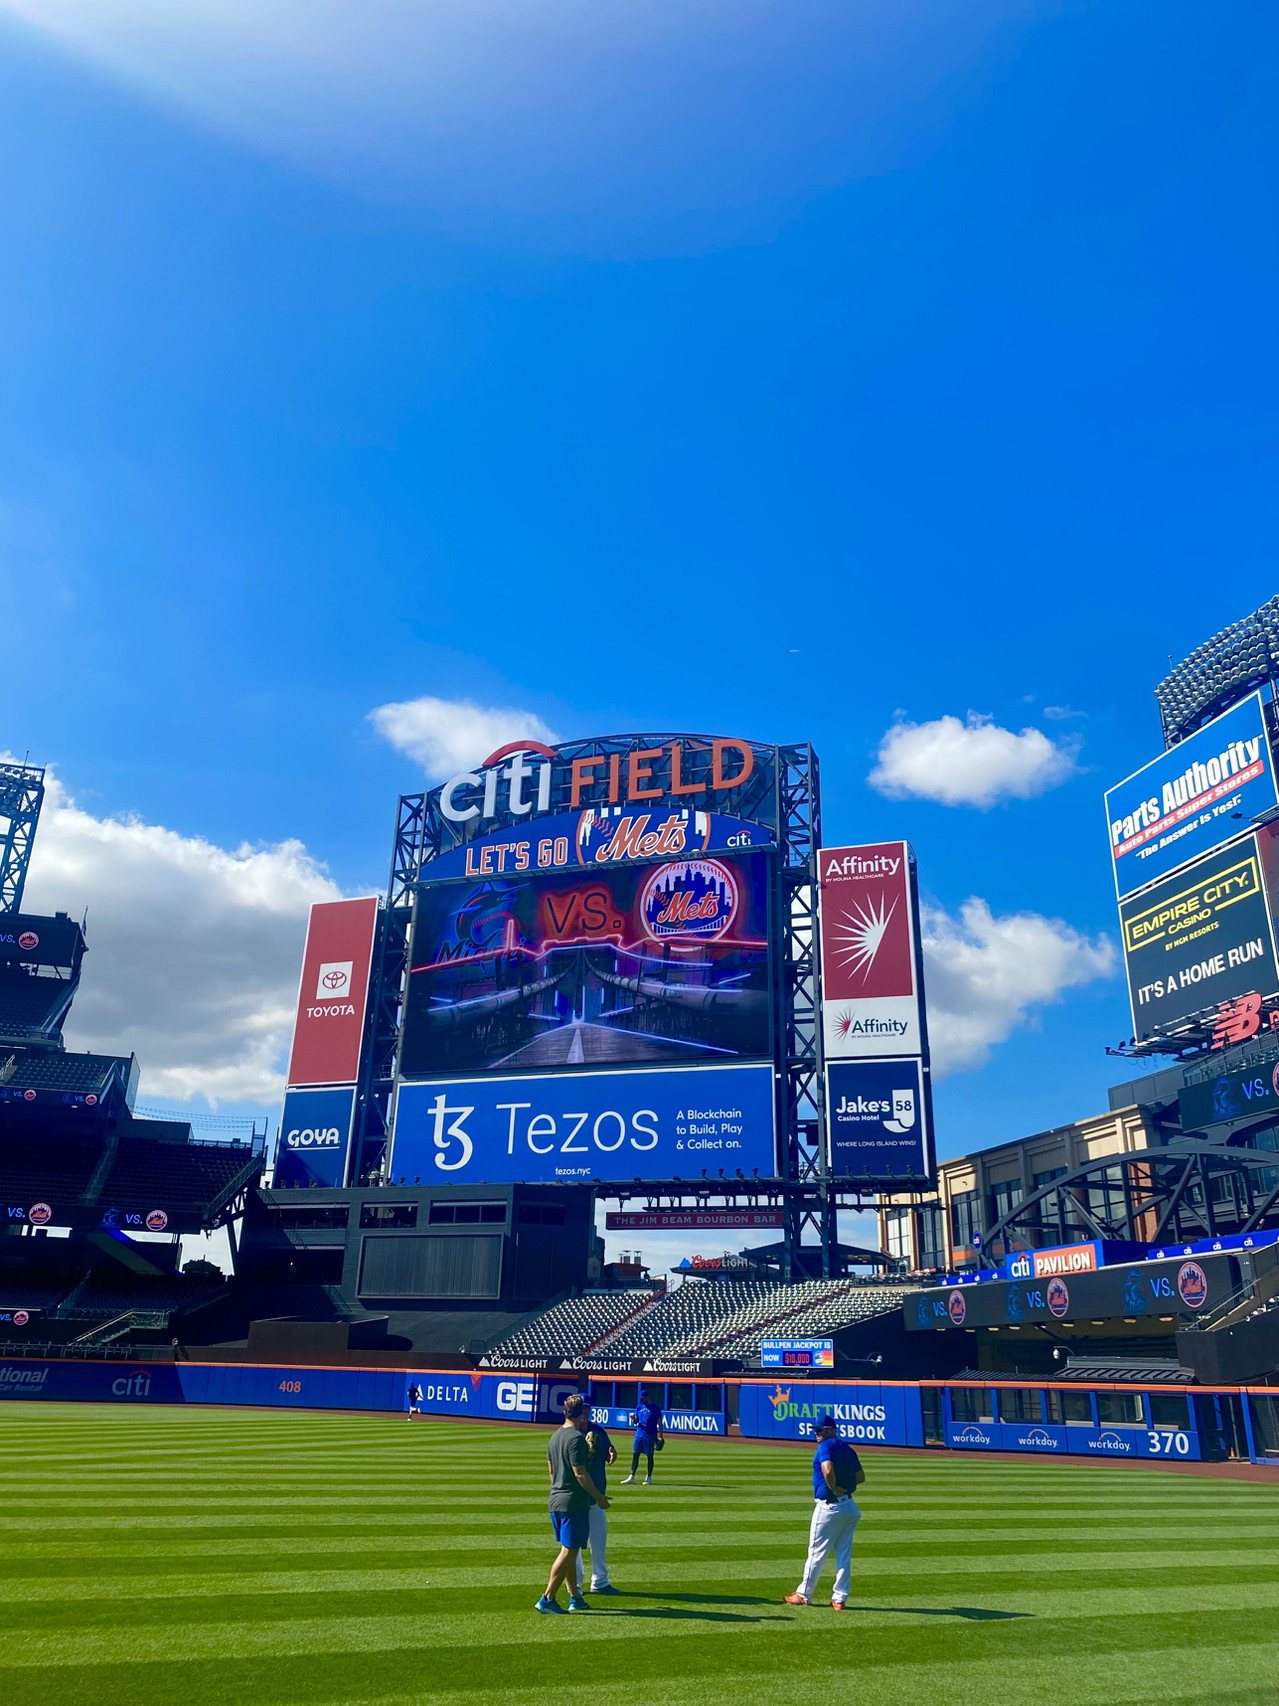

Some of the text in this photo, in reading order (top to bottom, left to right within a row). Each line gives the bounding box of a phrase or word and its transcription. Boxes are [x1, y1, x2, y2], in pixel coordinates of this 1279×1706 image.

[440, 739, 753, 822] citi FIELD
[1111, 736, 1260, 846] Parts Authority
[1118, 765, 1259, 854] Auto Parts Super Stores
[727, 833, 751, 847] citi
[1160, 819, 1198, 846] Answer
[465, 814, 688, 875] LET'S GO Mets
[826, 855, 900, 876] Affinity
[547, 892, 621, 933] VS.
[657, 891, 719, 922] Mets
[1132, 896, 1200, 939] EMPIRE
[1168, 909, 1211, 935] CASINO
[1165, 942, 1174, 951] BY
[1189, 921, 1219, 940] RESORTS
[1138, 938, 1264, 1005] IT'S A HOME RUN
[307, 1005, 355, 1018] TOYOTA
[851, 1018, 908, 1036] Affinity
[1242, 1079, 1269, 1100] VS.
[836, 1096, 912, 1113] Jake's 58
[676, 1108, 742, 1120] A Blockchain
[496, 1103, 658, 1154] Tezos
[676, 1123, 742, 1135] to Build, Play
[287, 1128, 339, 1147] GOYA
[676, 1139, 742, 1149] & Collect on.
[555, 1167, 591, 1176] tezos.nyc
[8, 1208, 26, 1218] VS.
[126, 1214, 143, 1224] VS.
[662, 1216, 691, 1224] BEAM
[754, 1215, 776, 1223] BAR
[1011, 1251, 1091, 1277] citi PAVILION
[1150, 1278, 1175, 1297] VS.
[1027, 1291, 1045, 1308] VS.
[933, 1301, 947, 1316] VS.
[490, 1354, 548, 1368] Coors LIGHT
[572, 1356, 632, 1371] Coors LIGHT
[653, 1357, 700, 1372] Coors LIGHT
[0, 1367, 48, 1383] tional
[112, 1375, 150, 1396] citi
[279, 1381, 301, 1392] 408
[427, 1386, 468, 1402] DELTA
[591, 1409, 608, 1424] 380
[670, 1415, 719, 1432] MINOLTA
[798, 1422, 886, 1440] SPSBOOK
[952, 1433, 990, 1445] workday
[1018, 1436, 1058, 1448] workday
[1088, 1439, 1130, 1451] workday
[1148, 1432, 1189, 1454] 370
